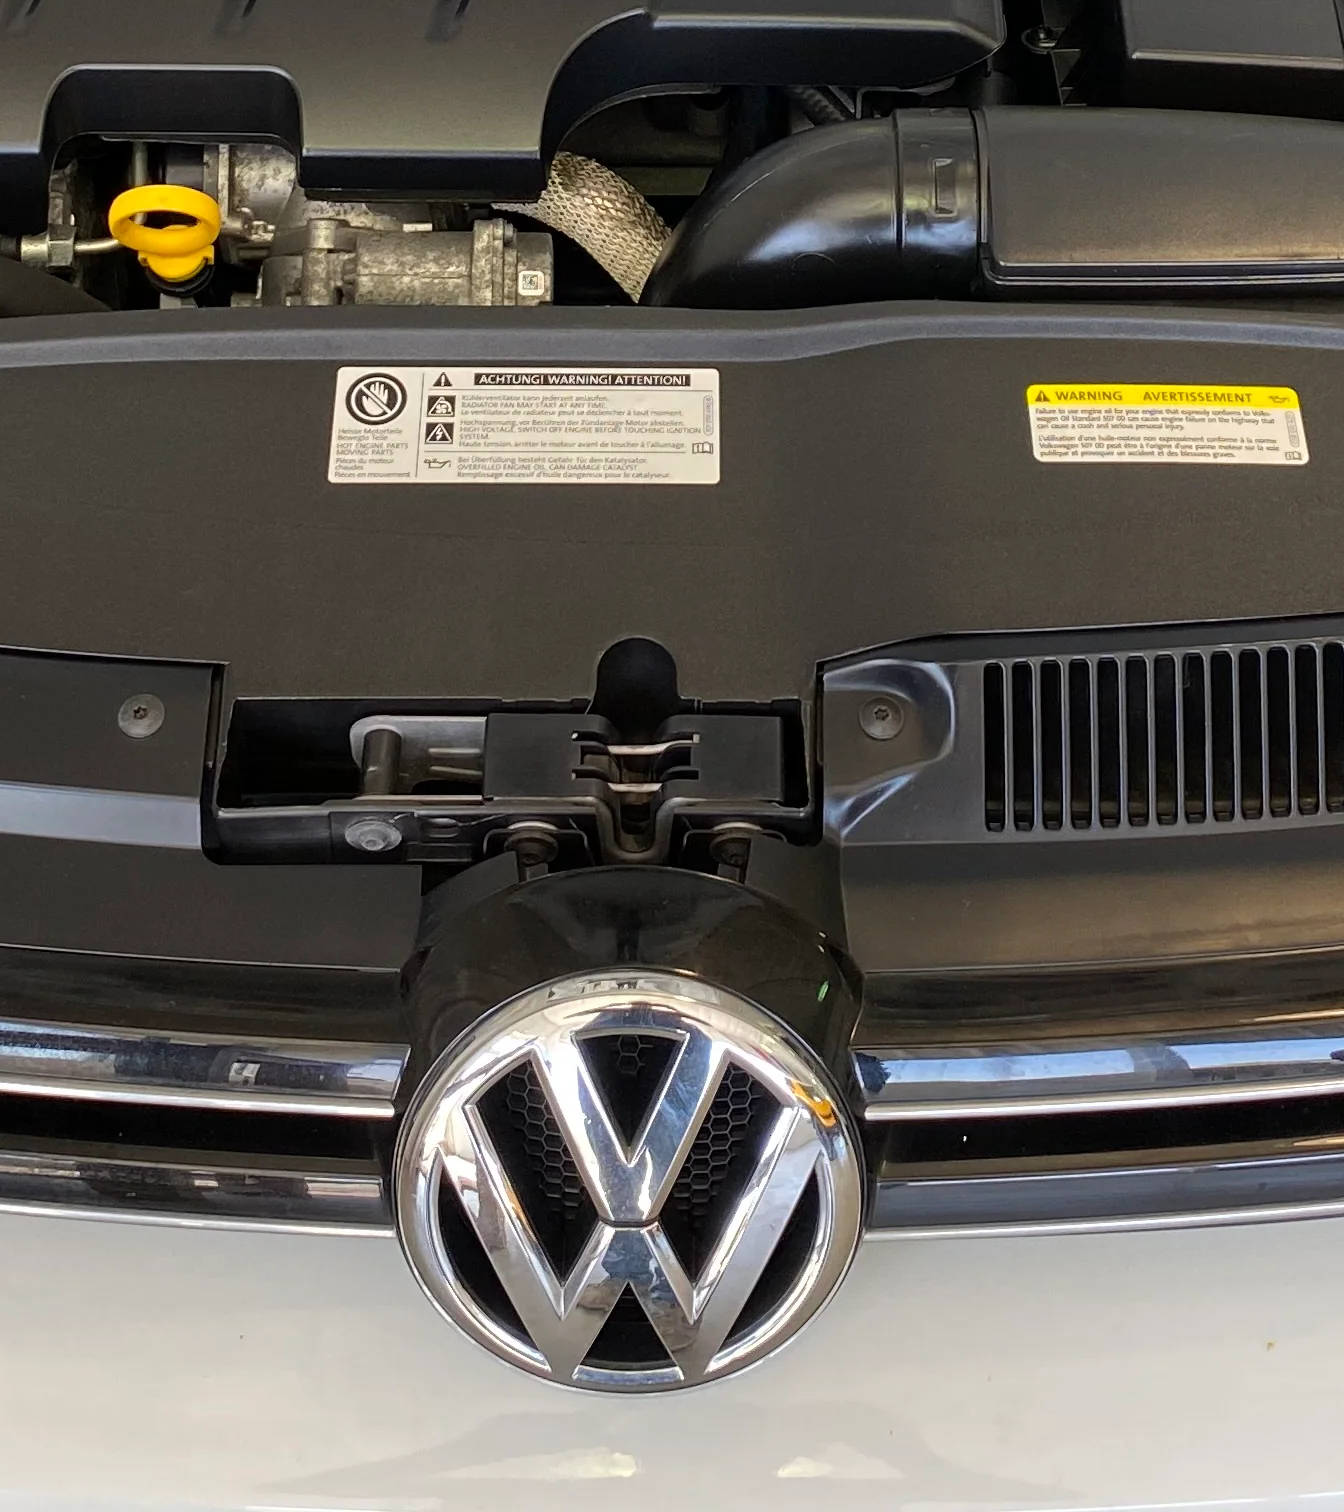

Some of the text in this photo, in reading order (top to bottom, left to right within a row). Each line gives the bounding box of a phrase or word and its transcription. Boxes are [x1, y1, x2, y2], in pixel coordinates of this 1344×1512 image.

[478, 374, 686, 386] ACHTUNG! WARNING! ATTENTION!
[1055, 391, 1253, 402] WARNING AVERTISSEMENT
[392, 967, 866, 1394] VW
